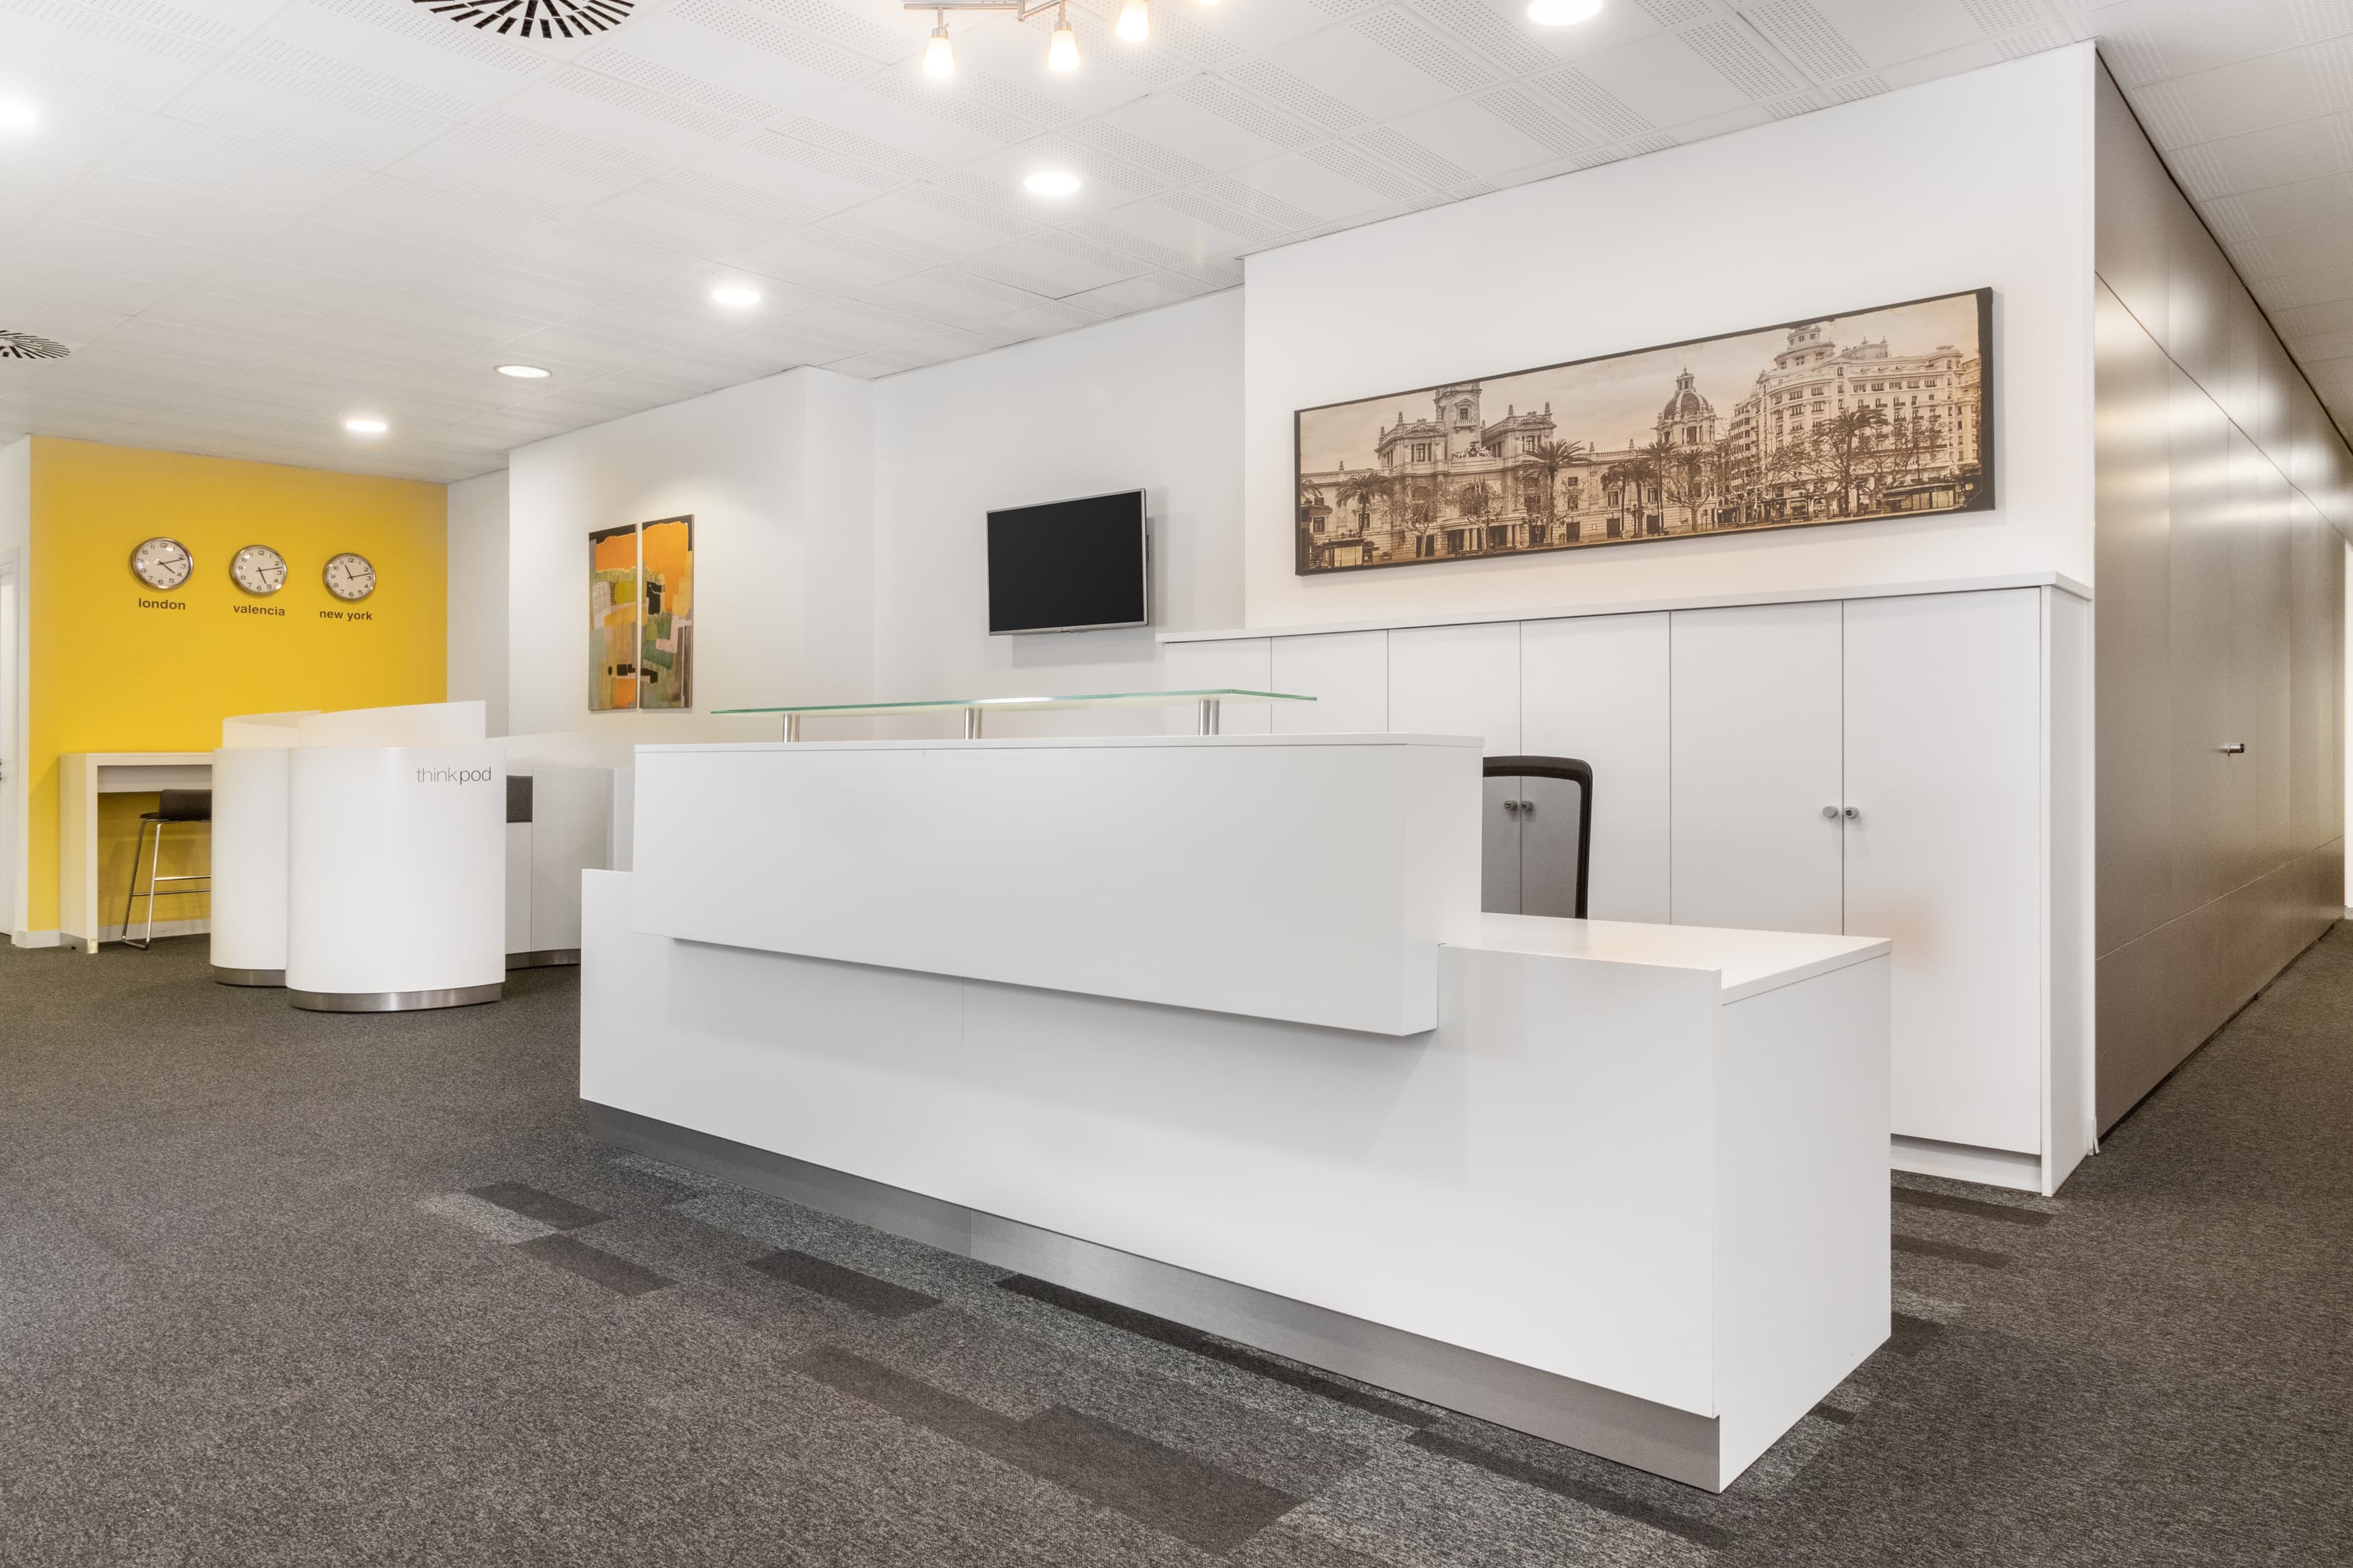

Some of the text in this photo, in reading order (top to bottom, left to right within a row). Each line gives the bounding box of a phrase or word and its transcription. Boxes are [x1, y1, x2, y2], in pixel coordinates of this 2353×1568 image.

[139, 598, 186, 610] london
[233, 604, 285, 616] valencia
[319, 610, 373, 621] new york
